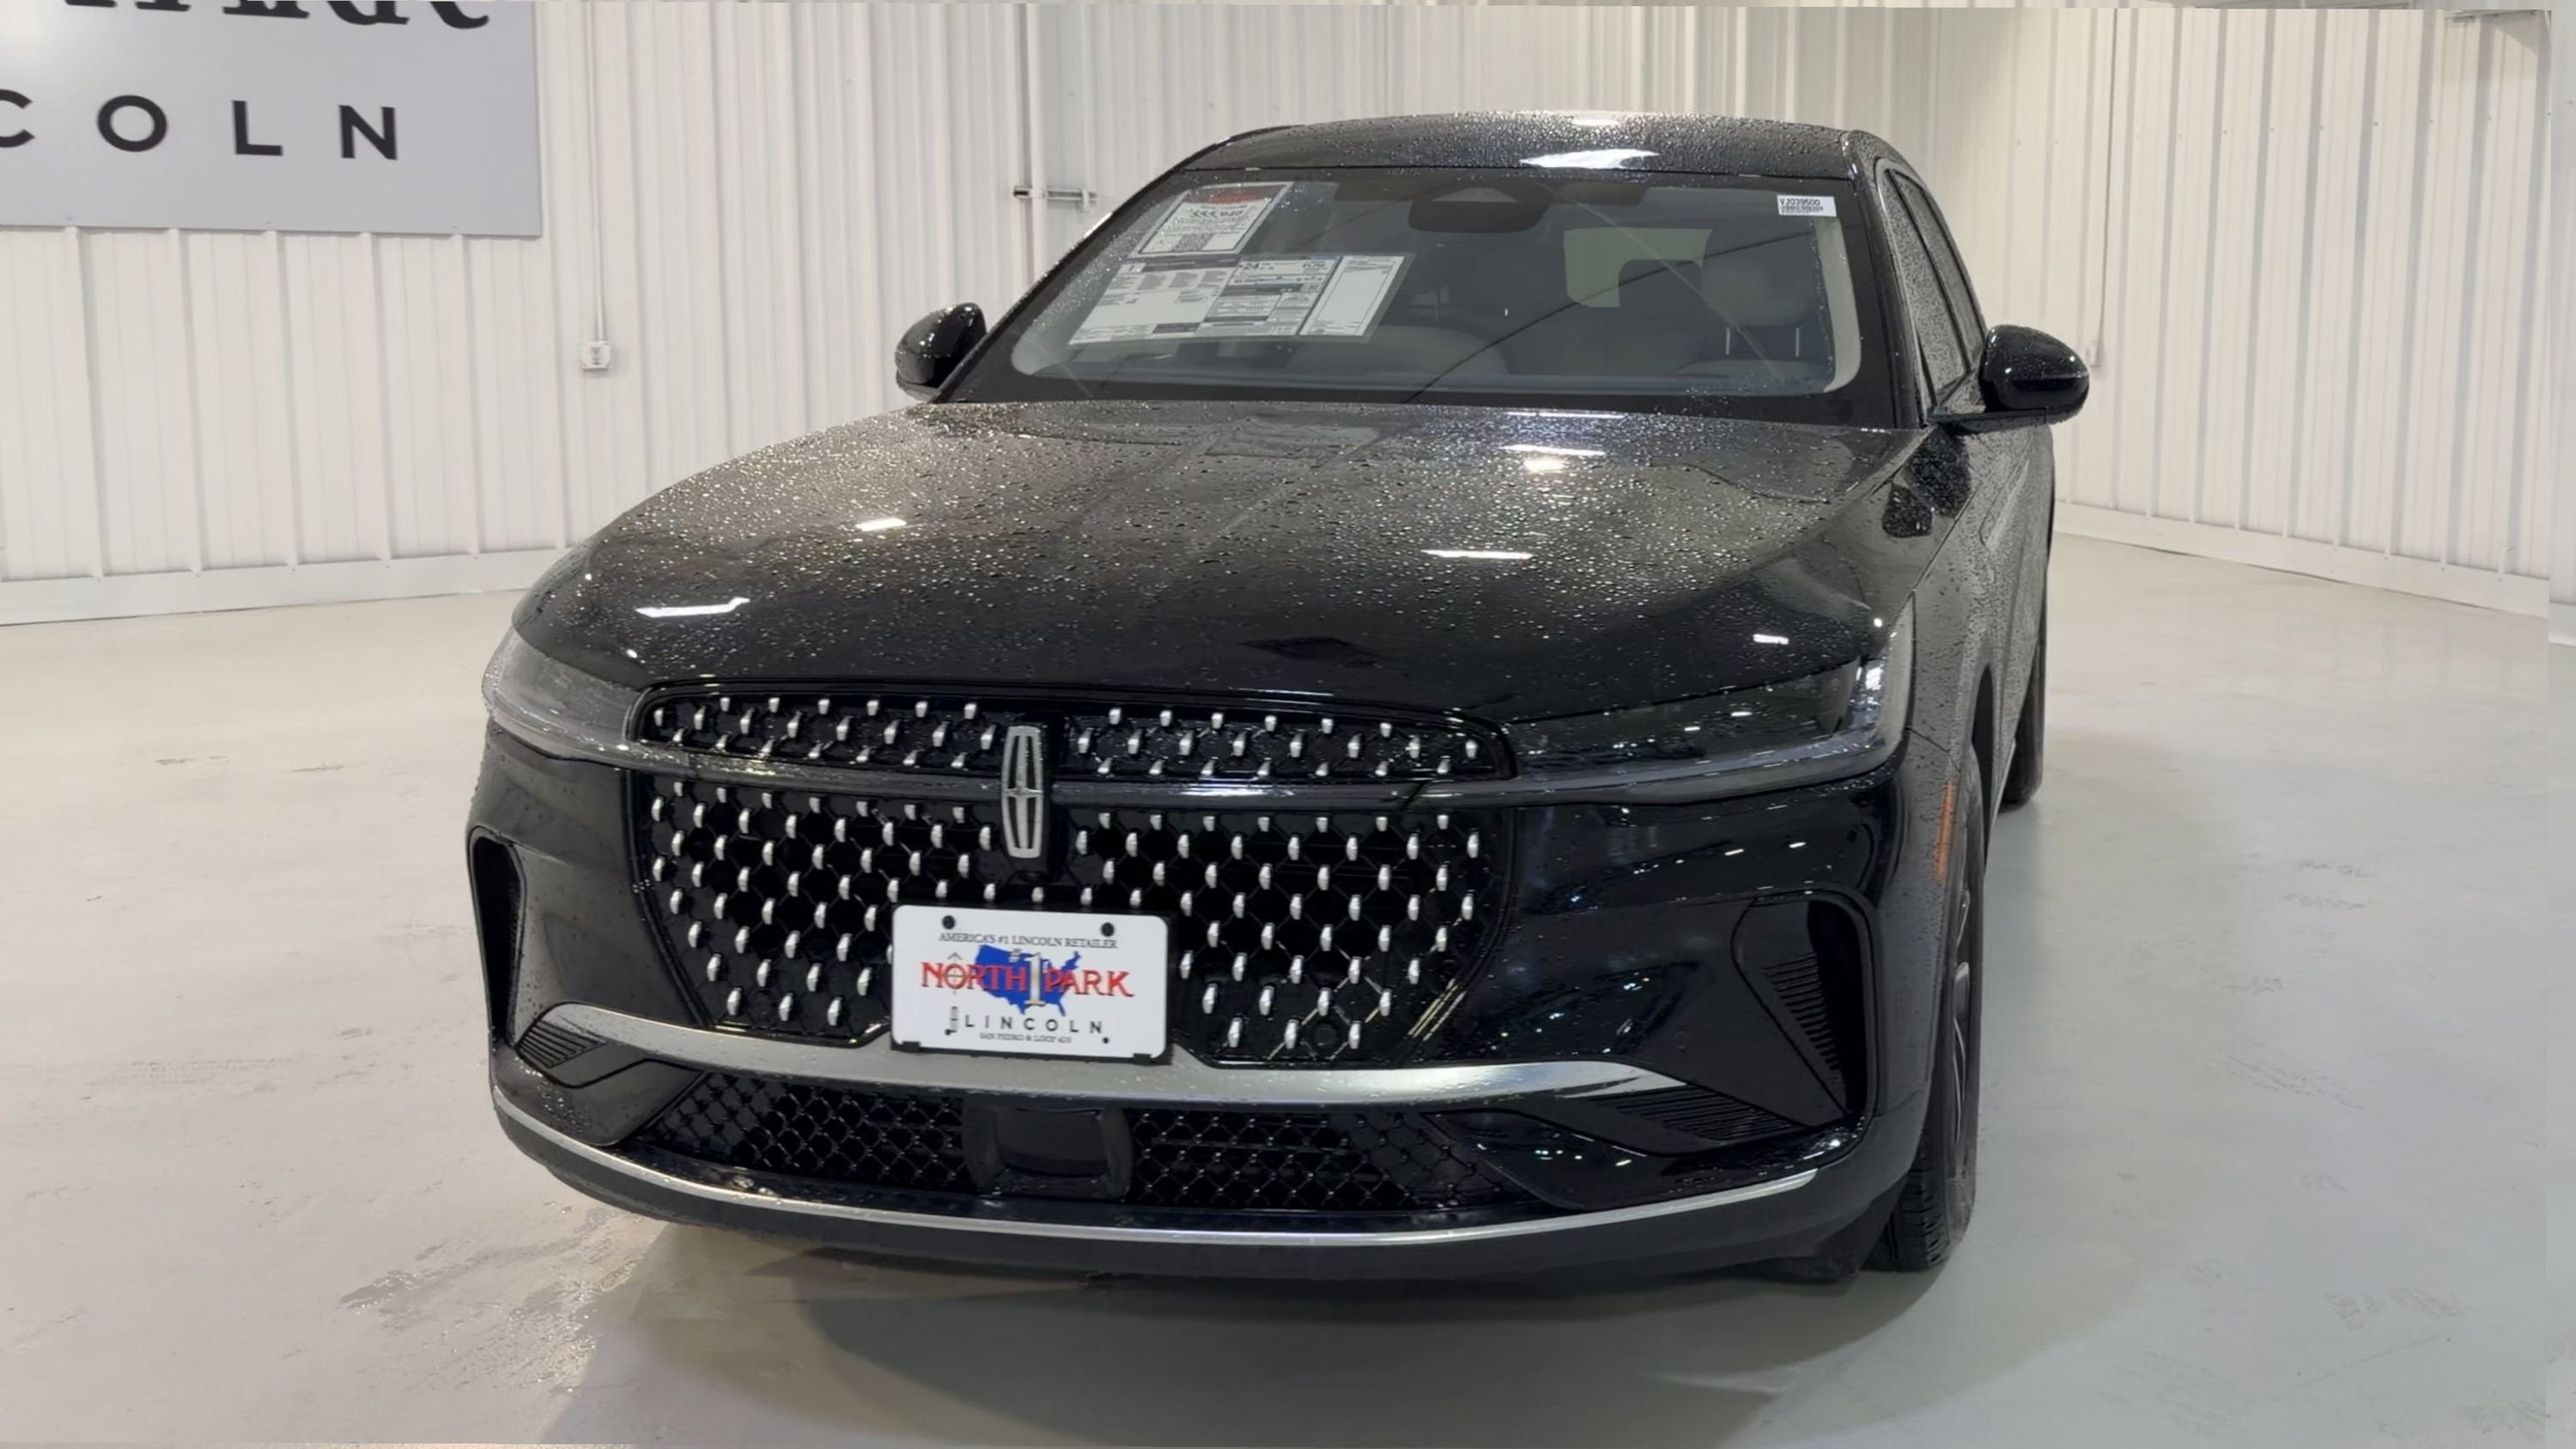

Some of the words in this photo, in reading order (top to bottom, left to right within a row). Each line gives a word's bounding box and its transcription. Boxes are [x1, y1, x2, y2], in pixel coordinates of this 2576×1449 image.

[939, 932, 996, 943] AMERICA'S
[998, 935, 1010, 944] #1
[1012, 935, 1063, 947] LINCOLN
[1065, 937, 1118, 949] RETAILER
[921, 961, 1026, 992] NORTH
[1043, 967, 1134, 997] PARK
[964, 1014, 1103, 1034] LINCOLN
